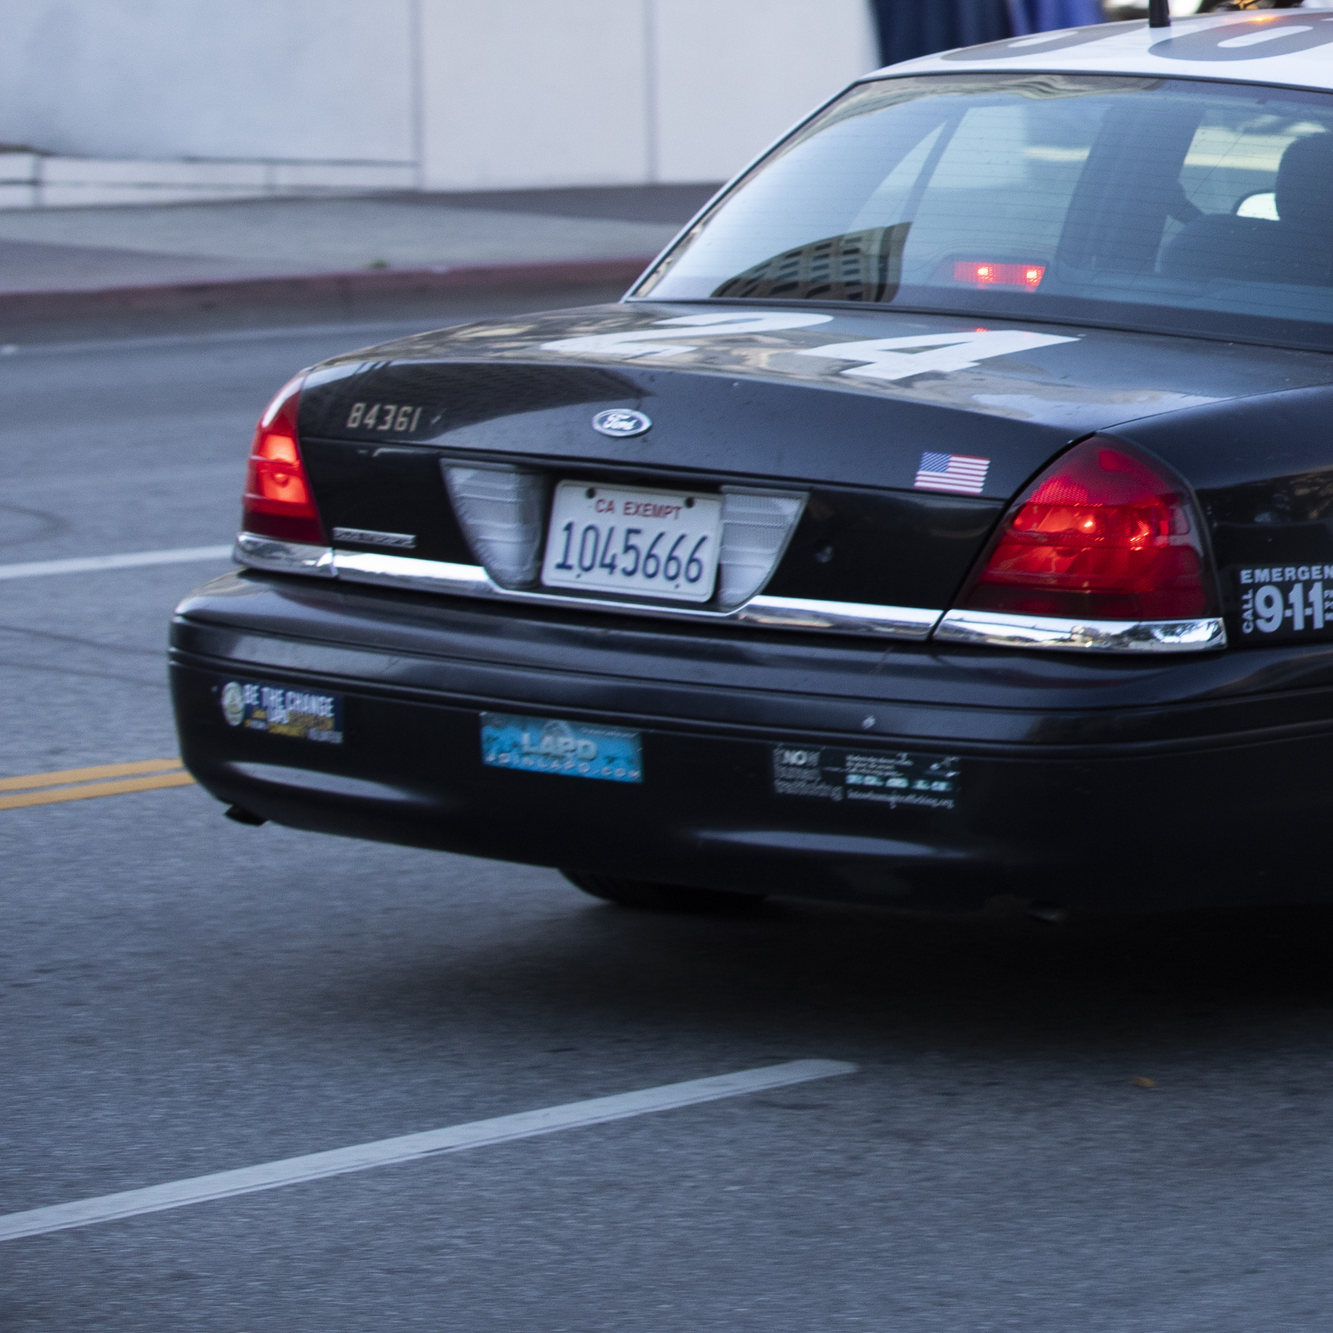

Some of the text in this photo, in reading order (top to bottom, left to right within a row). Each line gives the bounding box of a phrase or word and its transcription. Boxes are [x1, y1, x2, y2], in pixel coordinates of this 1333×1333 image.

[539, 311, 1081, 380] 24
[345, 401, 423, 433] 84361
[595, 497, 683, 520] CA EXEMPT
[555, 520, 709, 584] 1045666
[1241, 588, 1254, 634] CALL
[520, 731, 599, 762] LAPD
